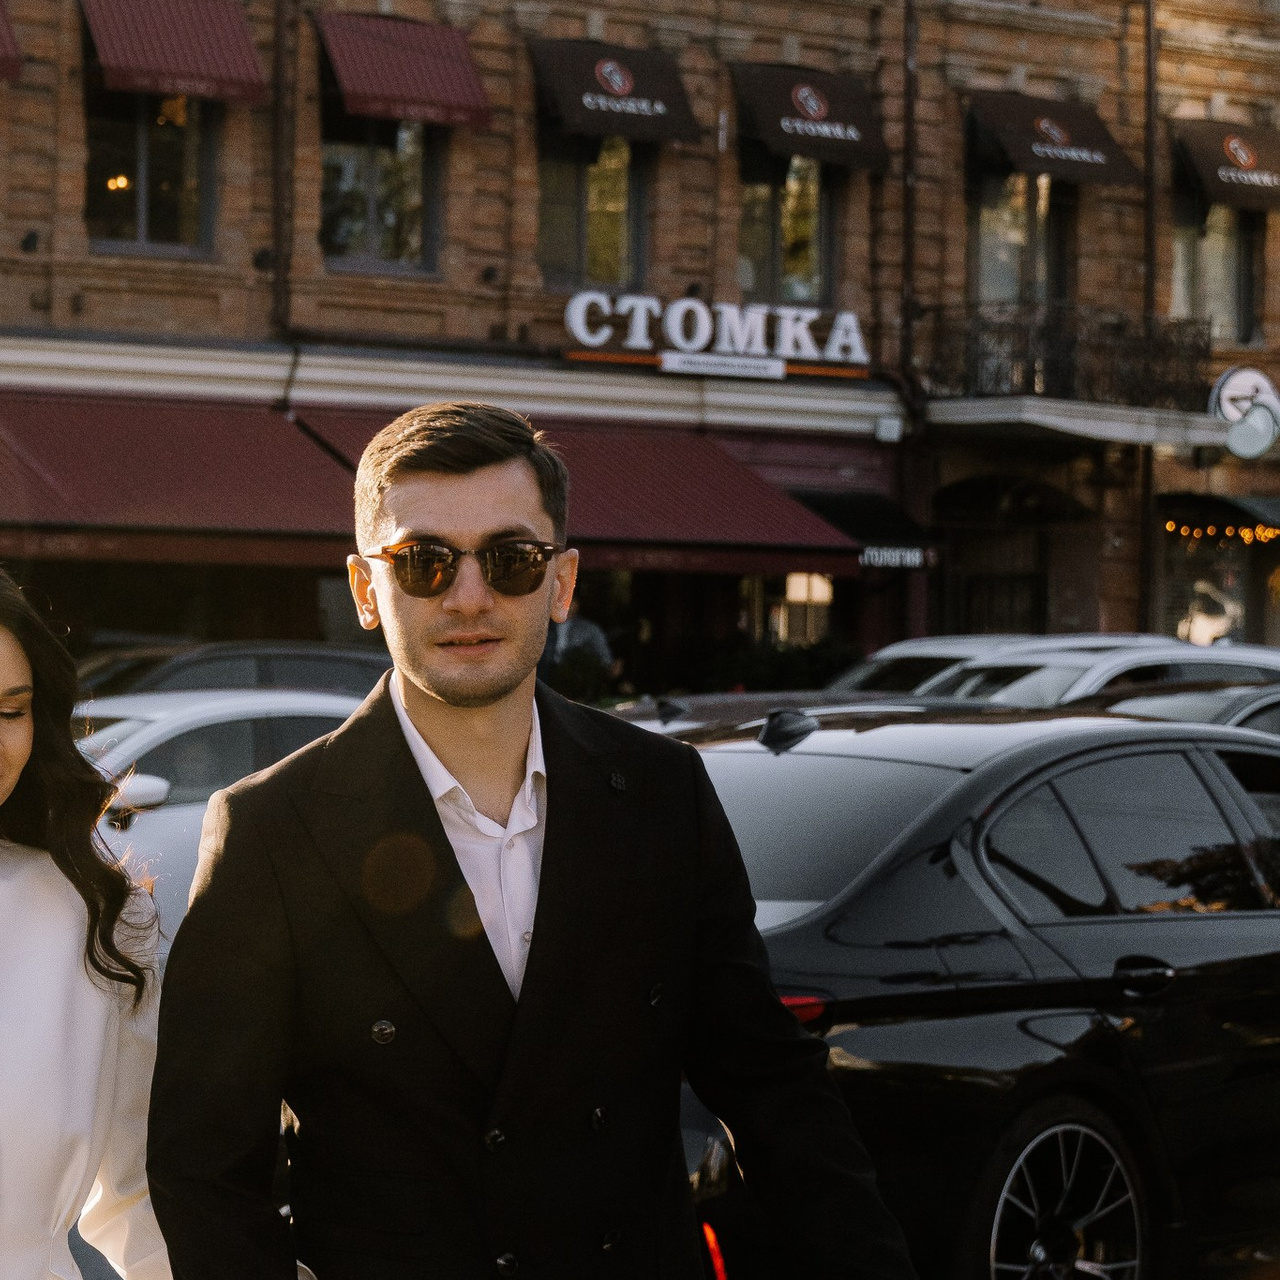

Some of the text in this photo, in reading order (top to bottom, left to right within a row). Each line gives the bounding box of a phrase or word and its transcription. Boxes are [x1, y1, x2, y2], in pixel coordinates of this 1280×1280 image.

[582, 92, 666, 115] СТОМКА
[780, 116, 860, 141] СТОМКА
[564, 290, 869, 364] СТОМКА
